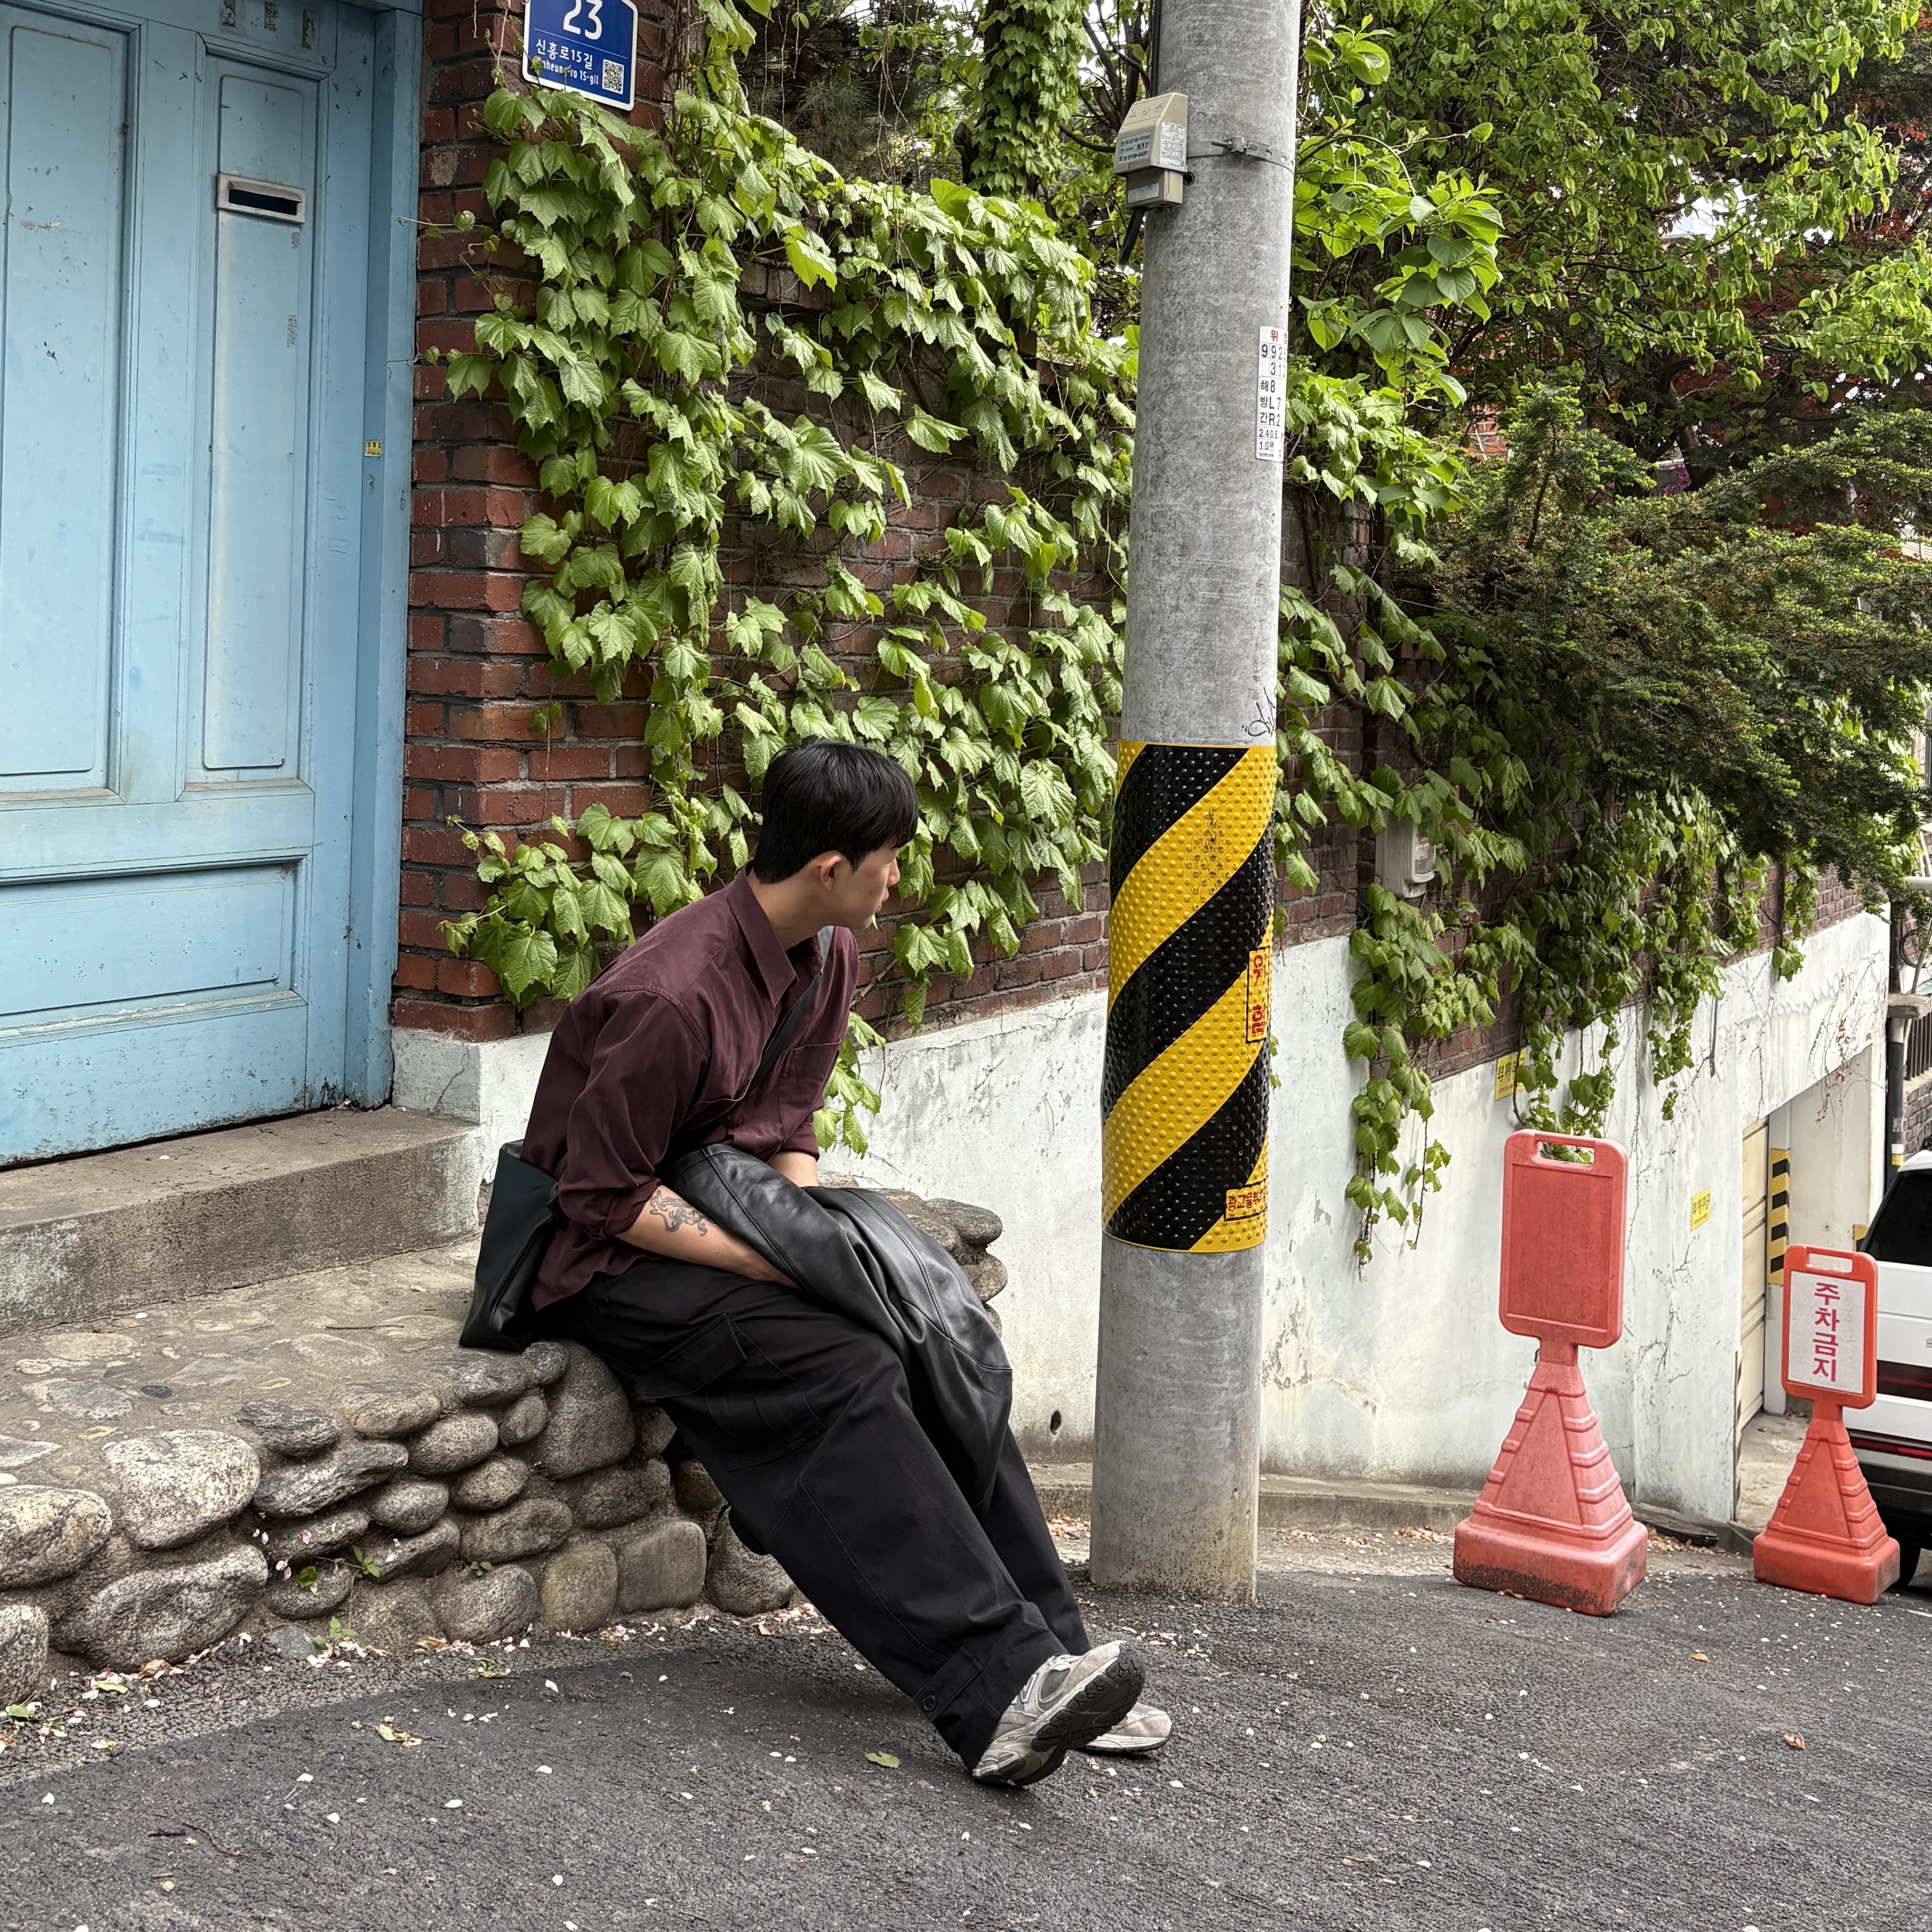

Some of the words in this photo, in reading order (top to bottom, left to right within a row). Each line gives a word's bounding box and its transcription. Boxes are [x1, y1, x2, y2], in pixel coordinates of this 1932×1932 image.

[563, 0, 603, 40] 23
[536, 39, 593, 70] 신흥로15길
[580, 70, 599, 86] 15-gil
[1812, 1282, 1840, 1382] 주차금지
